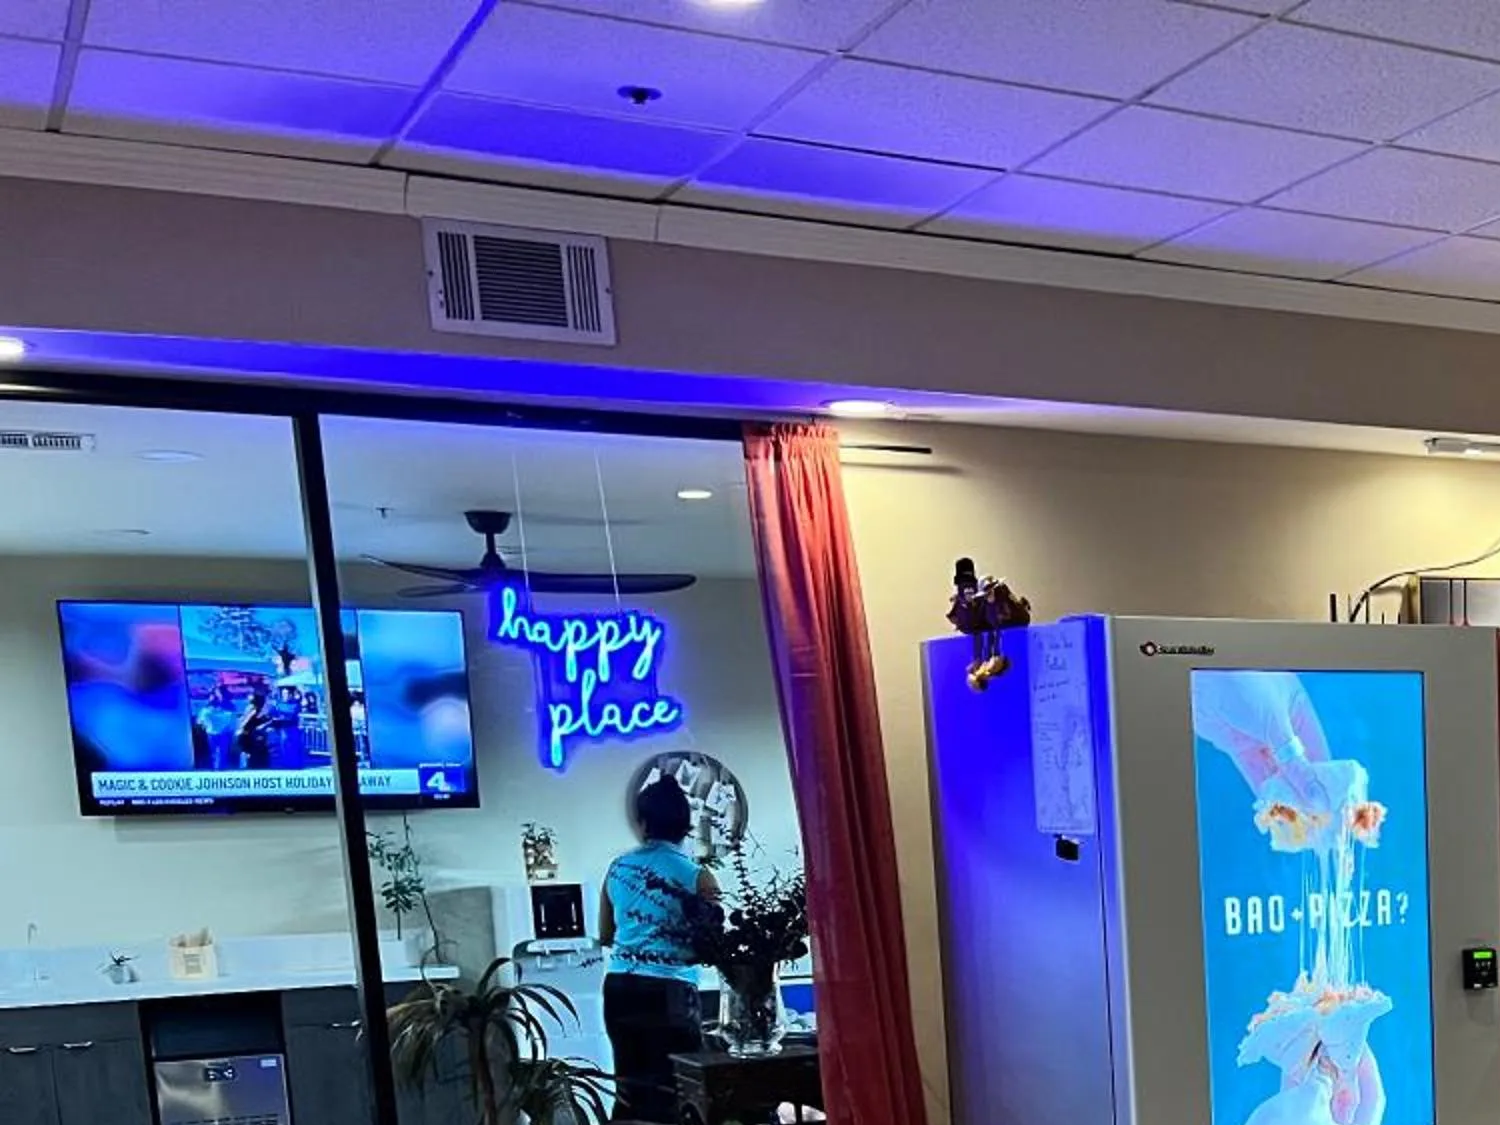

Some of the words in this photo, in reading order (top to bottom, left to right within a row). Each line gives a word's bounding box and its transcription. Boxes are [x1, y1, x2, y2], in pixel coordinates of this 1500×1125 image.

[497, 586, 662, 683] happy
[548, 668, 679, 767] place
[97, 779, 135, 791] MAGIC
[137, 779, 147, 791] &
[151, 778, 192, 791] COOKIE
[194, 777, 250, 790] JOHNSON
[253, 776, 282, 789] HOST
[285, 775, 333, 789] HOLIDAY
[426, 771, 449, 792] 4
